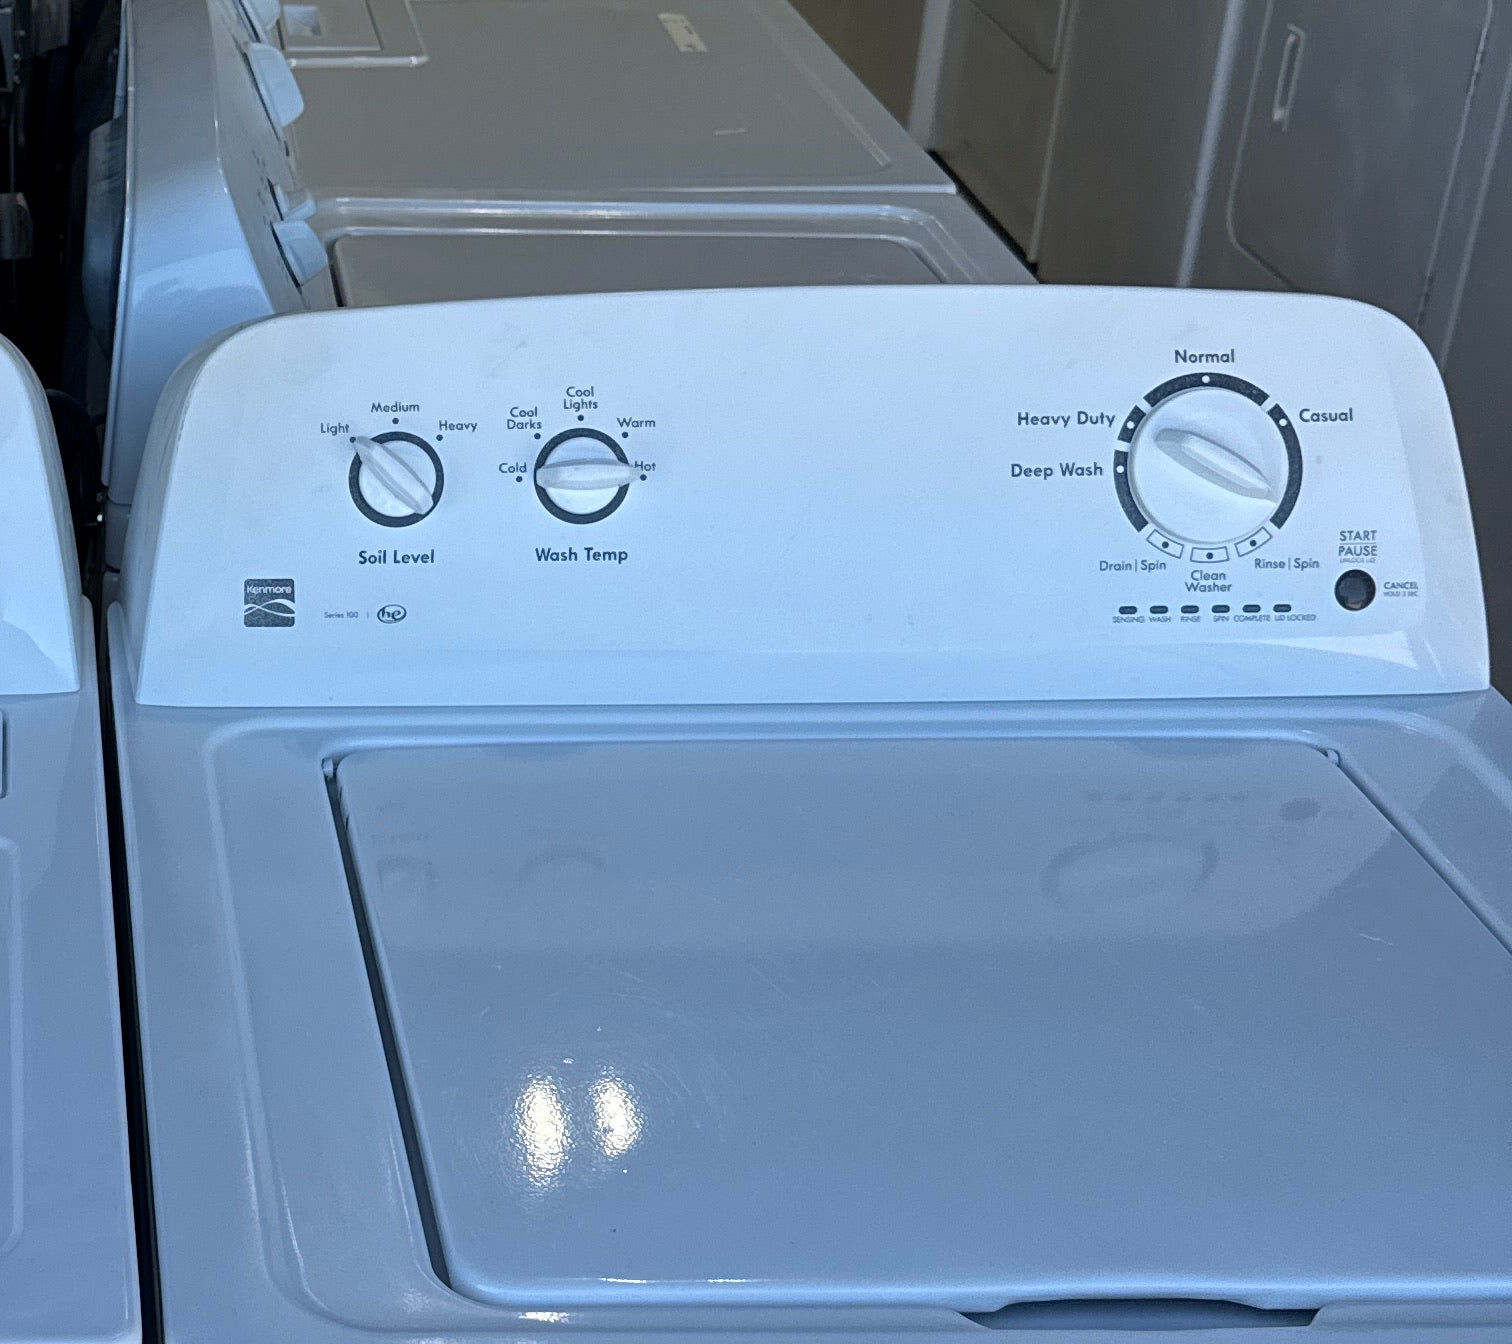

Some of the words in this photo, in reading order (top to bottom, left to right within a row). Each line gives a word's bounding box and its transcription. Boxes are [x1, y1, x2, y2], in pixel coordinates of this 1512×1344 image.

[1174, 348, 1235, 363] Normal
[565, 385, 595, 397] Cool
[370, 401, 420, 413] Medium
[563, 398, 599, 412] Lights
[509, 406, 538, 418] Cool
[1298, 407, 1354, 423] Casual
[506, 418, 543, 430] Darks
[616, 417, 656, 428] Warm
[1017, 411, 1071, 428] Heavy
[1077, 411, 1116, 427] Duty
[320, 422, 350, 437] Light
[438, 419, 478, 433] Heavy
[498, 462, 528, 474] Cold
[634, 460, 657, 472] Hot
[1011, 463, 1054, 480] Deep
[1059, 462, 1104, 477] Wash
[1339, 530, 1378, 542] START
[358, 549, 387, 565] Soil
[393, 548, 435, 565] Level
[535, 546, 578, 562] Wash
[583, 546, 629, 564] Temp
[1338, 545, 1378, 557] PAUSE
[1099, 559, 1133, 572] Drain
[1140, 559, 1167, 573] Spin
[1254, 557, 1286, 570] Rinse
[1293, 557, 1320, 571] Spin
[1190, 569, 1227, 582] Clean
[246, 585, 292, 594] Kenmore
[1184, 581, 1233, 593] Washer
[1383, 581, 1419, 590] CANCEL
[324, 611, 345, 619] Series
[1148, 615, 1172, 623] WASH
[1233, 614, 1271, 622] COMPLETE
[1286, 613, 1317, 622] LOCKED
